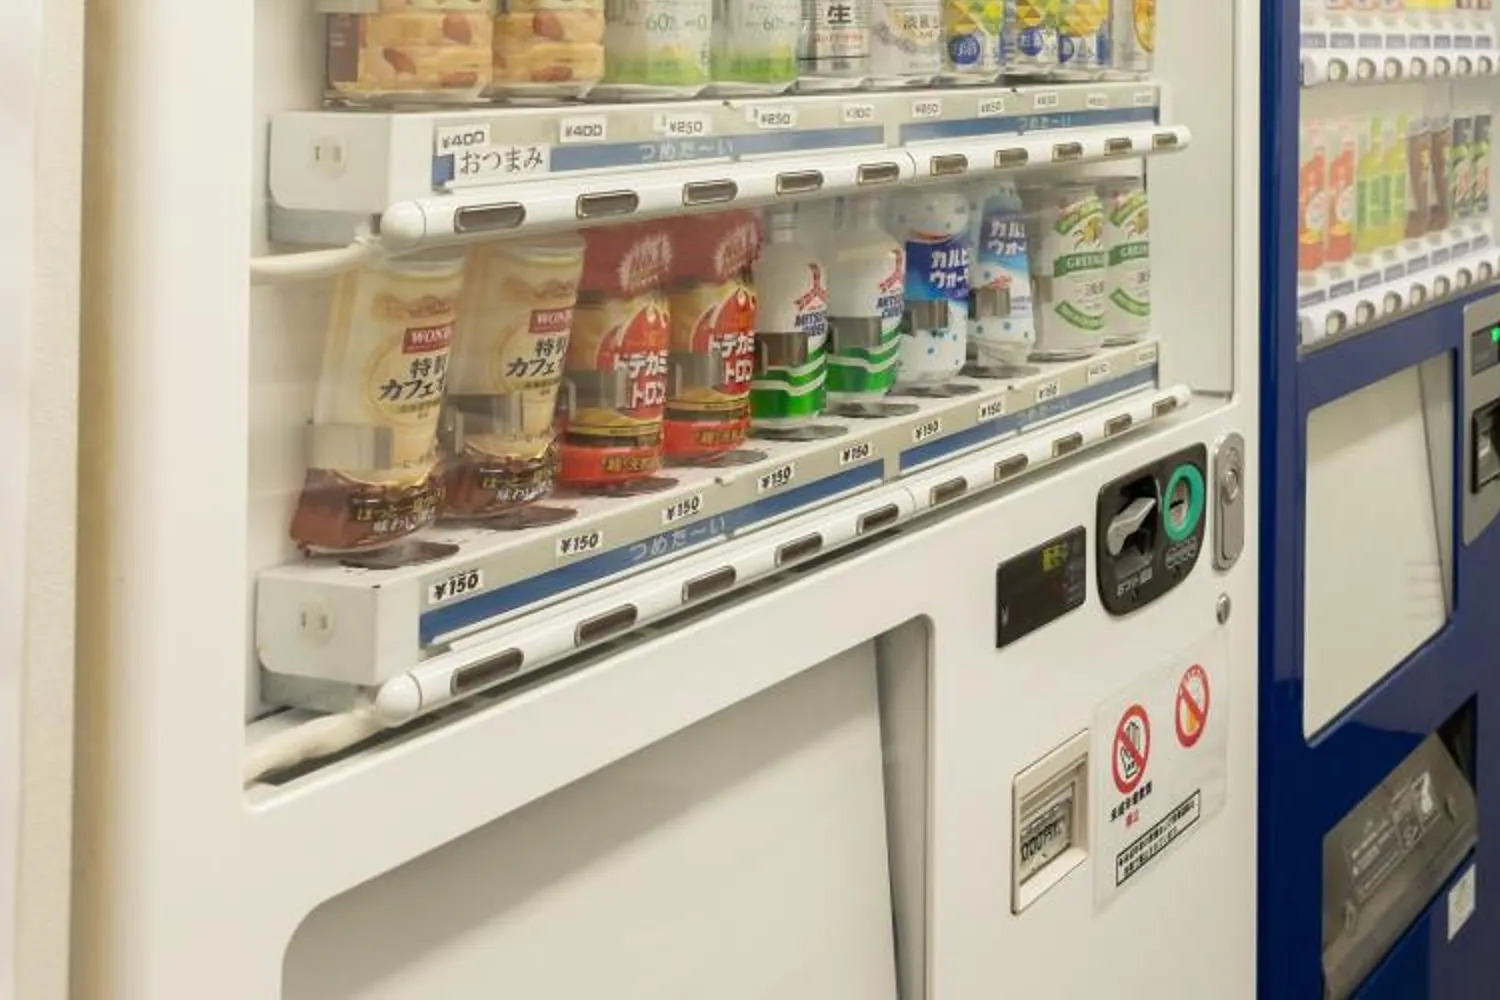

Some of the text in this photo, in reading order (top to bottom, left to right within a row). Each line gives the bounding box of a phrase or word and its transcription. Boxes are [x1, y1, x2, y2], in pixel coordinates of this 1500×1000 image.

[827, 4, 853, 25] 生
[442, 130, 485, 149] ¥400
[565, 122, 603, 137] ¥400
[459, 146, 544, 175] おつまみ
[665, 496, 700, 521] ¥150
[559, 532, 600, 553] ¥150
[432, 571, 480, 601] ¥150
